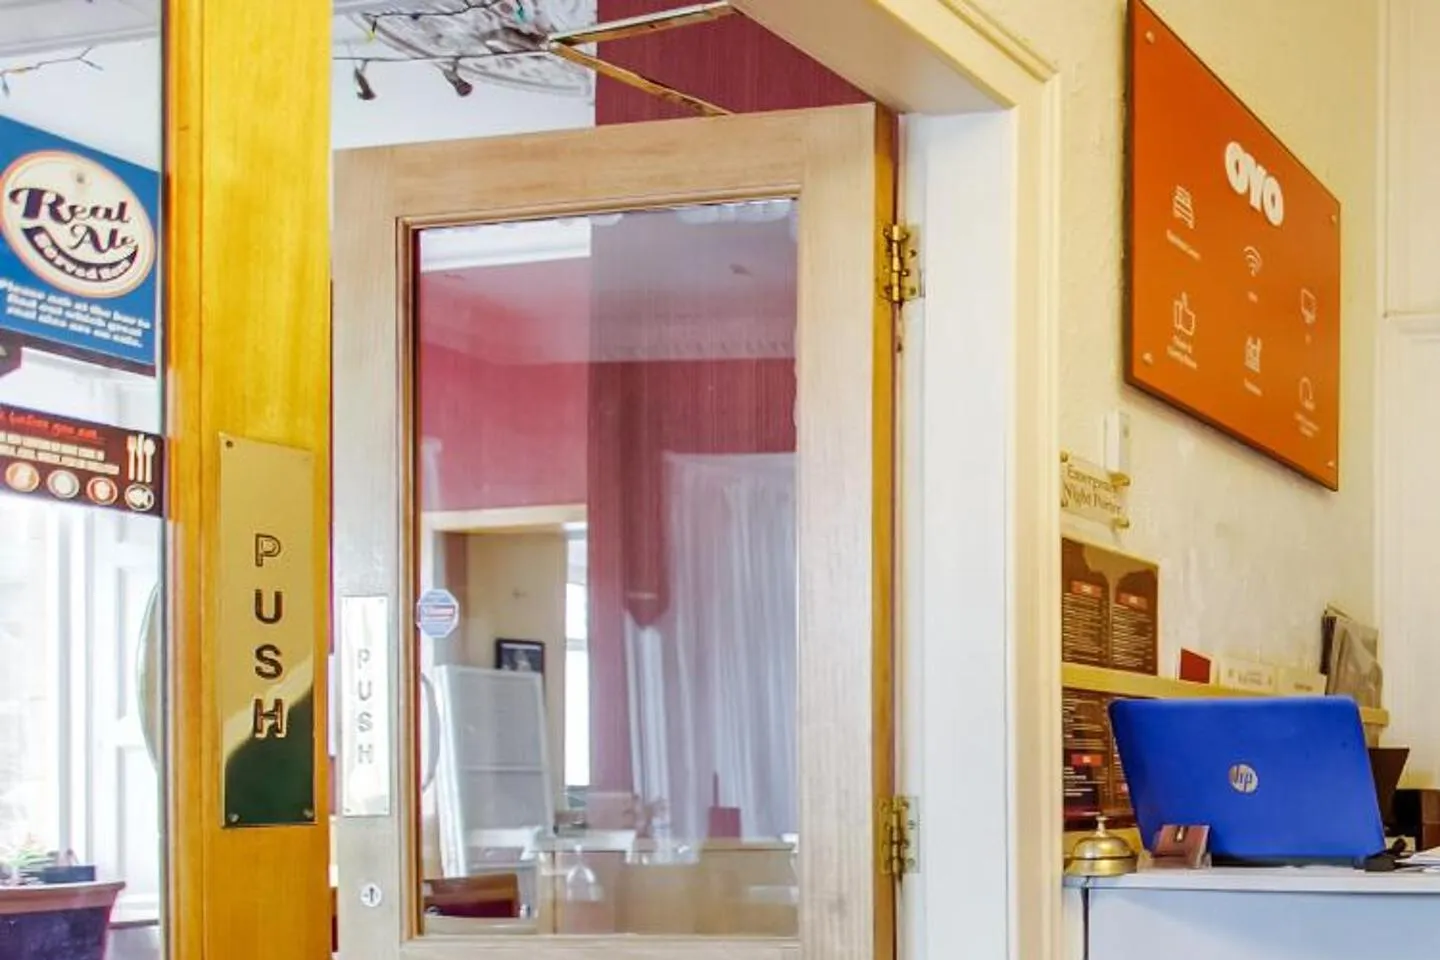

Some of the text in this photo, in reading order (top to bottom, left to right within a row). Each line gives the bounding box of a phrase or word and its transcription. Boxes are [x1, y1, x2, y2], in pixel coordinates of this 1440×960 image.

[9, 188, 131, 224] Real
[1224, 141, 1284, 227] OYO
[70, 224, 134, 253] Ale
[253, 533, 286, 739] PUSH
[357, 648, 373, 765] PUSH
[1231, 763, 1255, 792] hp
